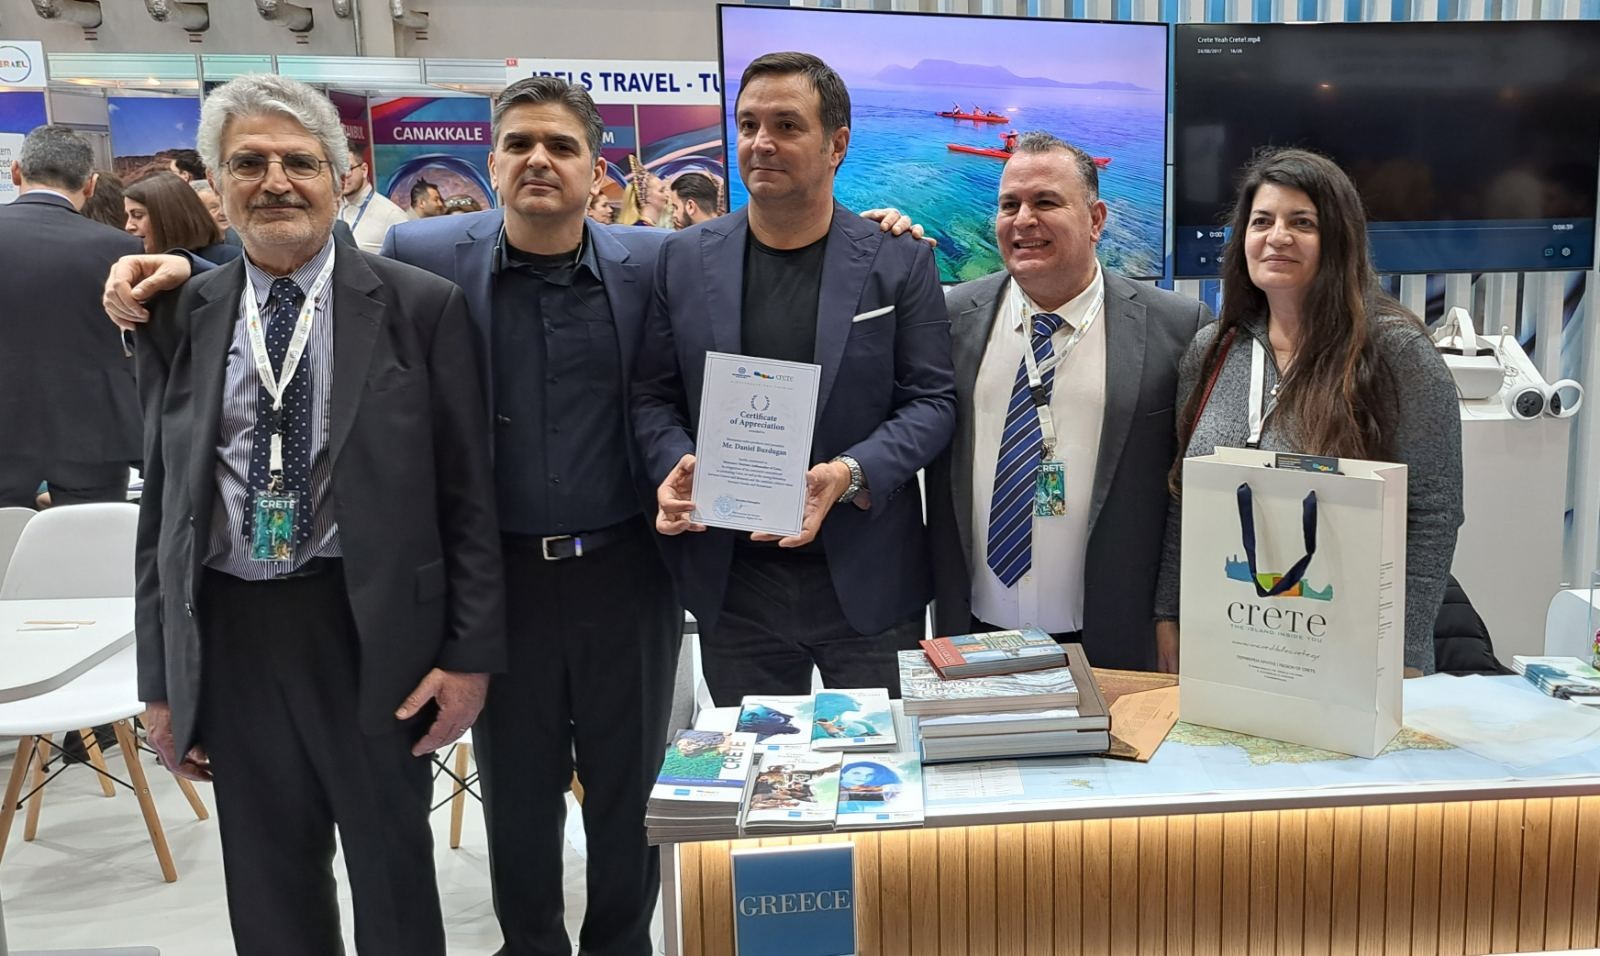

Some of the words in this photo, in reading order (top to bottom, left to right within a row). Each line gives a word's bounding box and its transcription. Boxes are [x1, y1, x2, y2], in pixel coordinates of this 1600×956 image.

[599, 72, 681, 92] TRAVEL
[393, 127, 483, 141] CANAKKALE
[740, 410, 777, 422] Certificate
[739, 419, 785, 431] Appreciation
[735, 443, 755, 452] Daniel
[1037, 464, 1065, 472] CRETE
[260, 499, 295, 509] CRETE
[1247, 627, 1275, 635] ISLAND
[1277, 631, 1304, 640] INSIDE
[739, 889, 851, 917] GREECE
